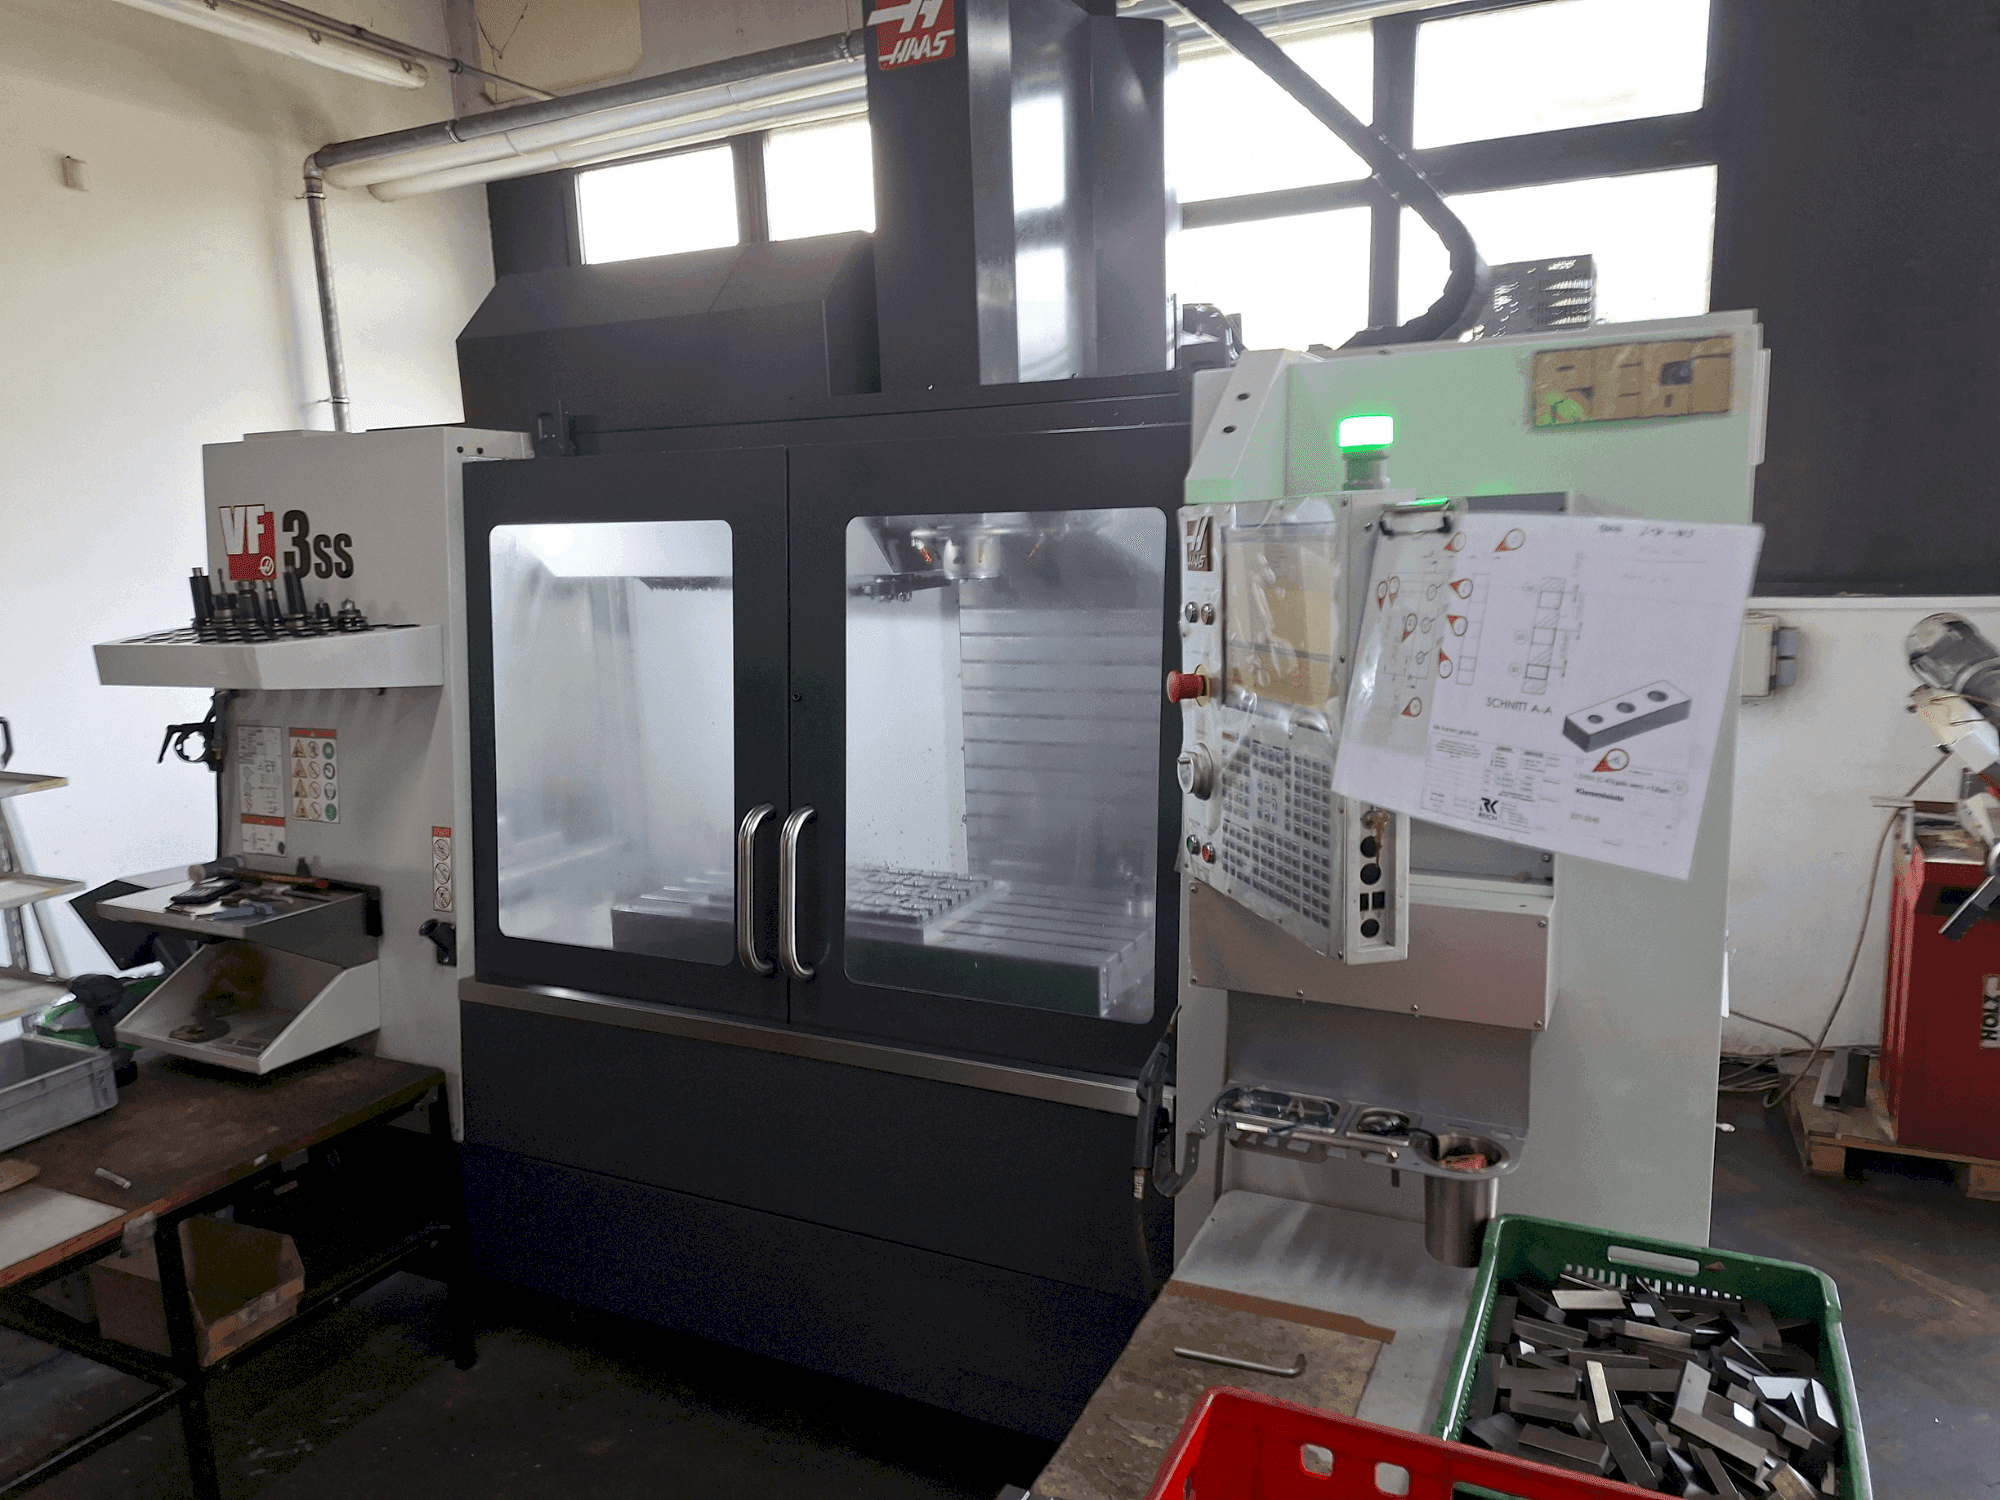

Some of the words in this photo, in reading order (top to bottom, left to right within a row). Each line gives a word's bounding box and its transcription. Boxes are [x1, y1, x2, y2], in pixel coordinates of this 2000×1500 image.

[878, 28, 956, 65] HAAS
[219, 504, 265, 556] VF
[1486, 697, 1528, 712] SCHNITT
[1530, 704, 1553, 715] A-A
